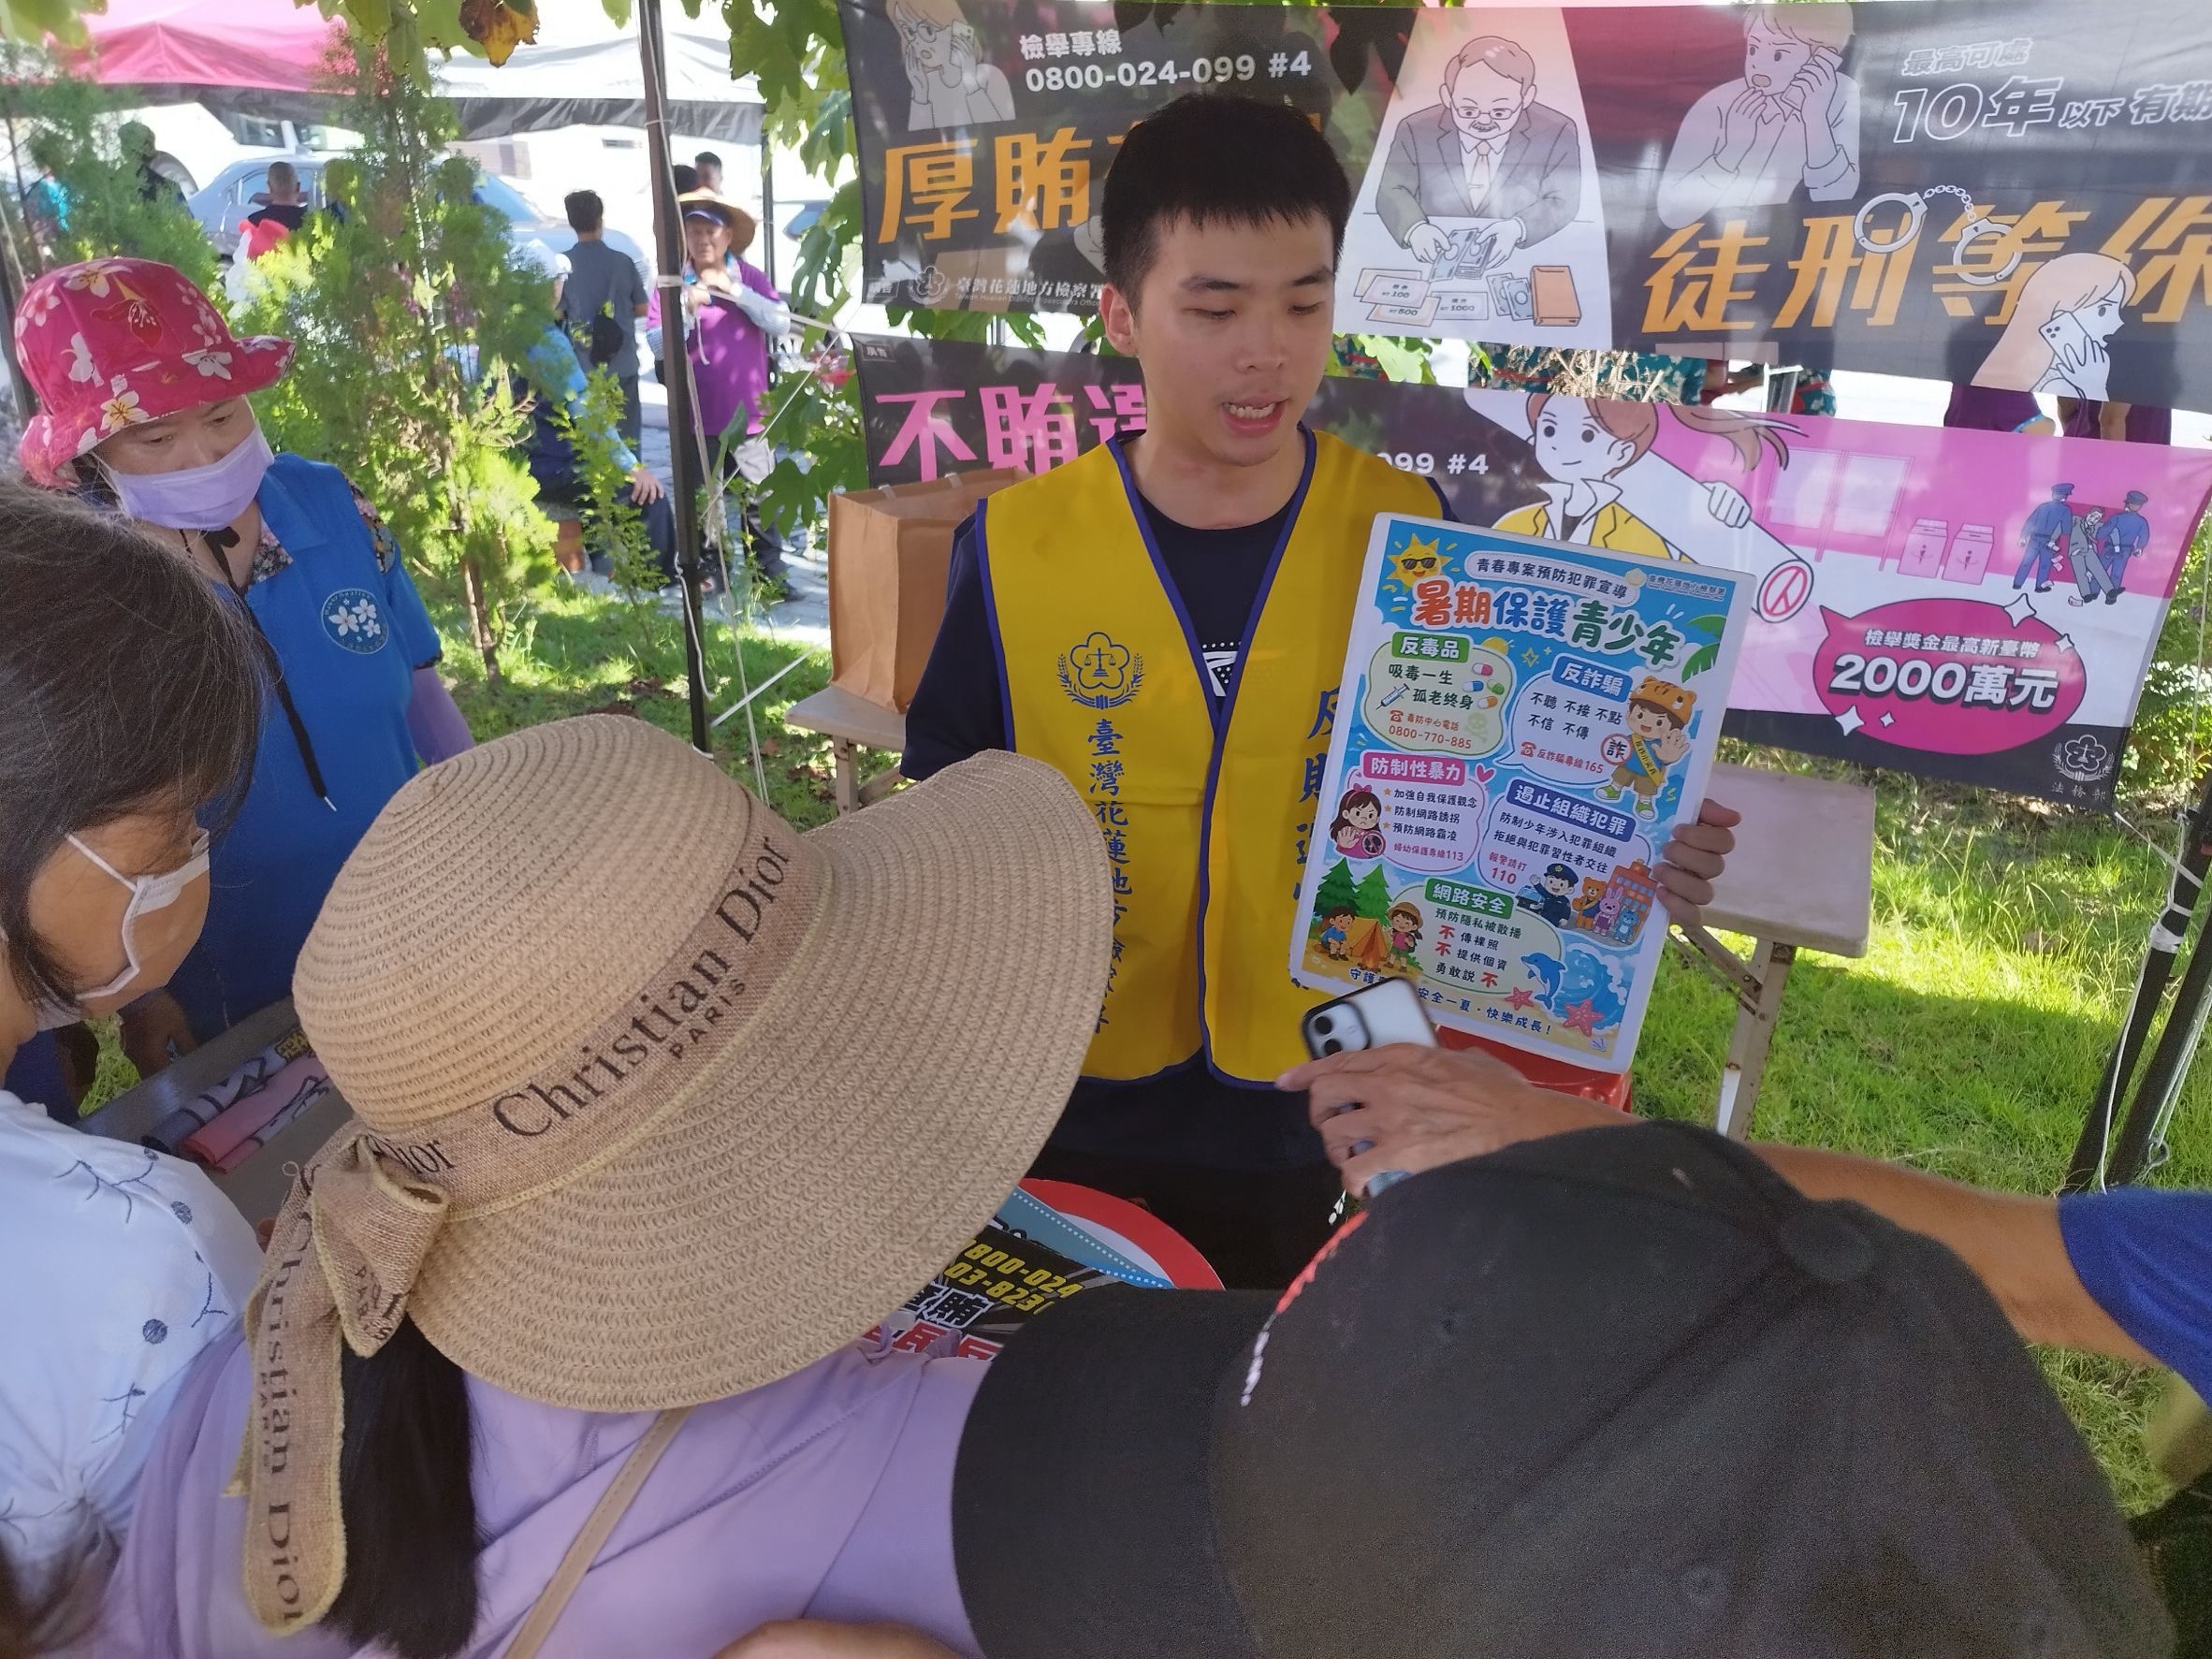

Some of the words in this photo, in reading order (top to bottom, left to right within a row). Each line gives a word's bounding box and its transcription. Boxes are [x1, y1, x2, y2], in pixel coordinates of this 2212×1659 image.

[1019, 28, 1122, 60] 檢舉專線
[1901, 37, 2034, 76] 最高可處
[1026, 54, 1256, 93] 0800-024-099
[1268, 51, 1311, 79] #4
[879, 127, 1125, 244] 厚賄
[1448, 453, 1489, 475] #4
[1477, 559, 1628, 599] 青春專案預防犯罪宣導
[1414, 579, 1681, 665] 暑期保護青少年
[1399, 636, 1461, 660] 反毒品
[1864, 629, 2041, 659] 檢舉獎金最高新臺幣
[1389, 663, 1453, 686] 吸毒一生
[1560, 662, 1623, 697] 反詐騙
[1830, 654, 2059, 709] 2000萬元
[1412, 688, 1474, 710] 孤老終身
[1389, 725, 1472, 749] 0800-770-885
[1371, 757, 1461, 781] 防制性暴力
[1393, 788, 1477, 808] 加強自我保護觀念
[1515, 784, 1627, 836] 遏止組織犯罪
[1394, 806, 1460, 824] 防制網路誘拐
[1493, 829, 1609, 874] 拒絕與犯罪習性者交往
[1499, 811, 1618, 859] 防制少年涉入犯罪組織
[1491, 866, 1517, 885] 110
[1433, 882, 1506, 914] 網路安全
[1435, 908, 1522, 939] 預防隱私被散播
[492, 948, 733, 1138] Christian
[714, 836, 791, 945] Dior
[668, 978, 748, 1059] PARIS
[965, 1239, 1084, 1299] 800-024
